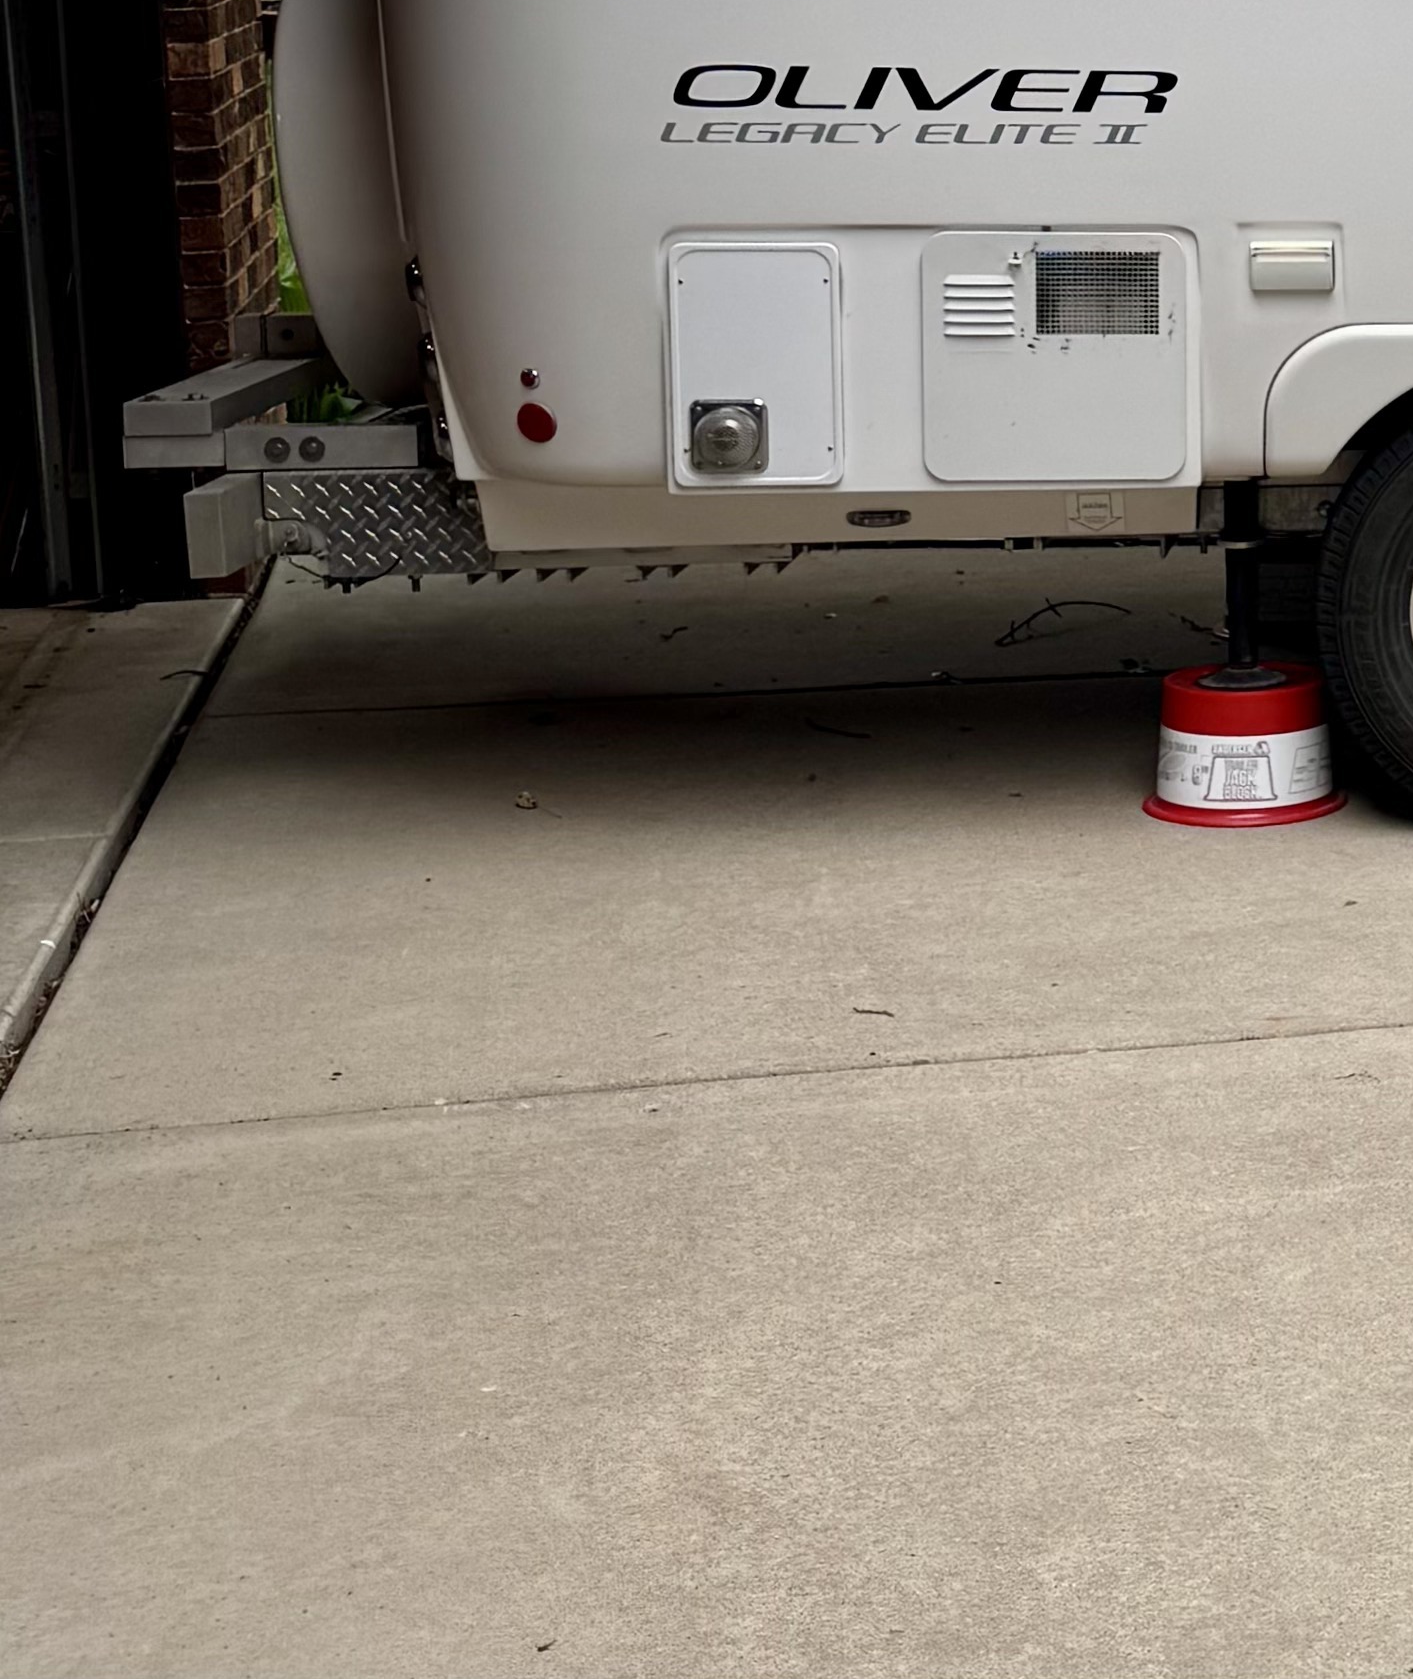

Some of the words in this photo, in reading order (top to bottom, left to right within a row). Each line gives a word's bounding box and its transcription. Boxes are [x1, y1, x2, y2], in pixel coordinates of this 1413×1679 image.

[673, 64, 1179, 114] OLIVER
[660, 122, 902, 144] LEGACY
[914, 123, 1082, 144] ELITE
[1092, 124, 1149, 145] II
